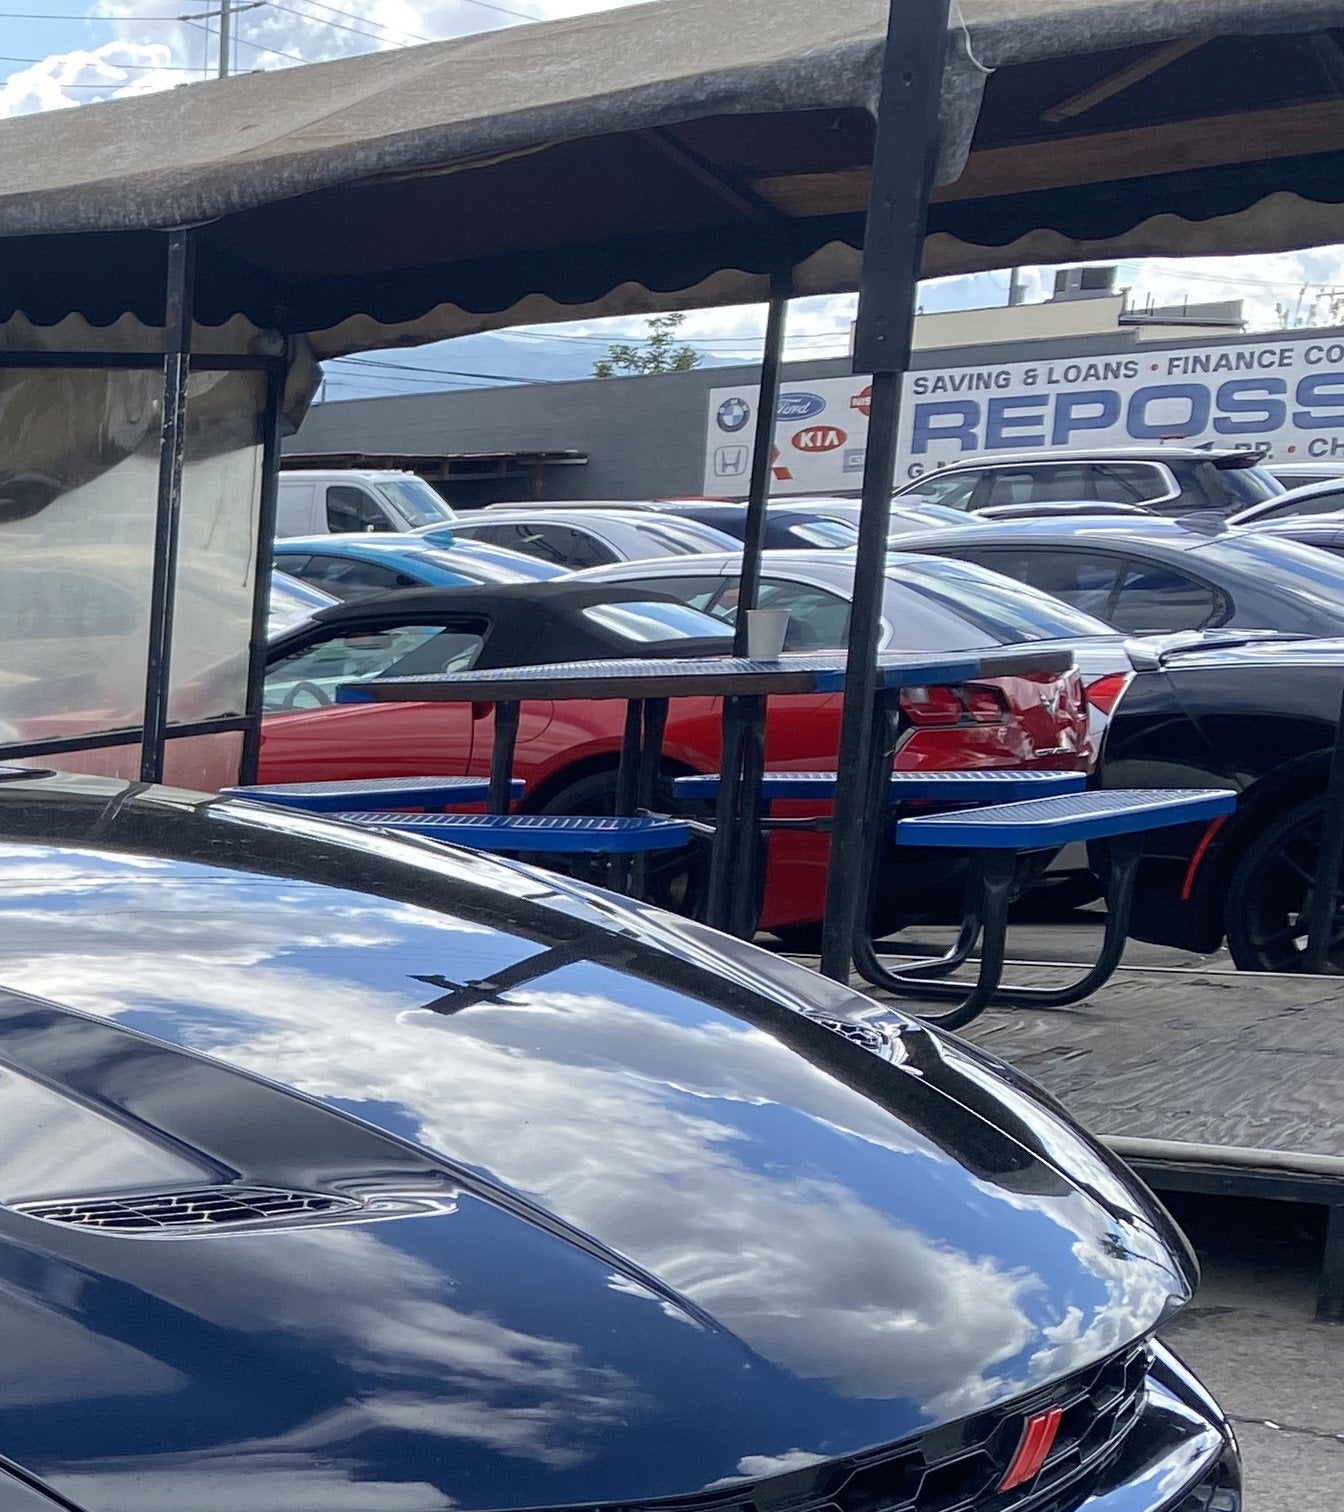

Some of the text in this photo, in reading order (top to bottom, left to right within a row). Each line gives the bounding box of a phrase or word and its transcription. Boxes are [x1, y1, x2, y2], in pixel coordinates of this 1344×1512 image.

[913, 370, 1012, 396] SAVING
[1023, 367, 1039, 386] &
[1046, 360, 1140, 386] LOANS
[1167, 348, 1295, 376] FINANCE
[910, 371, 1344, 455] REPOSS
[799, 430, 840, 448] KIA
